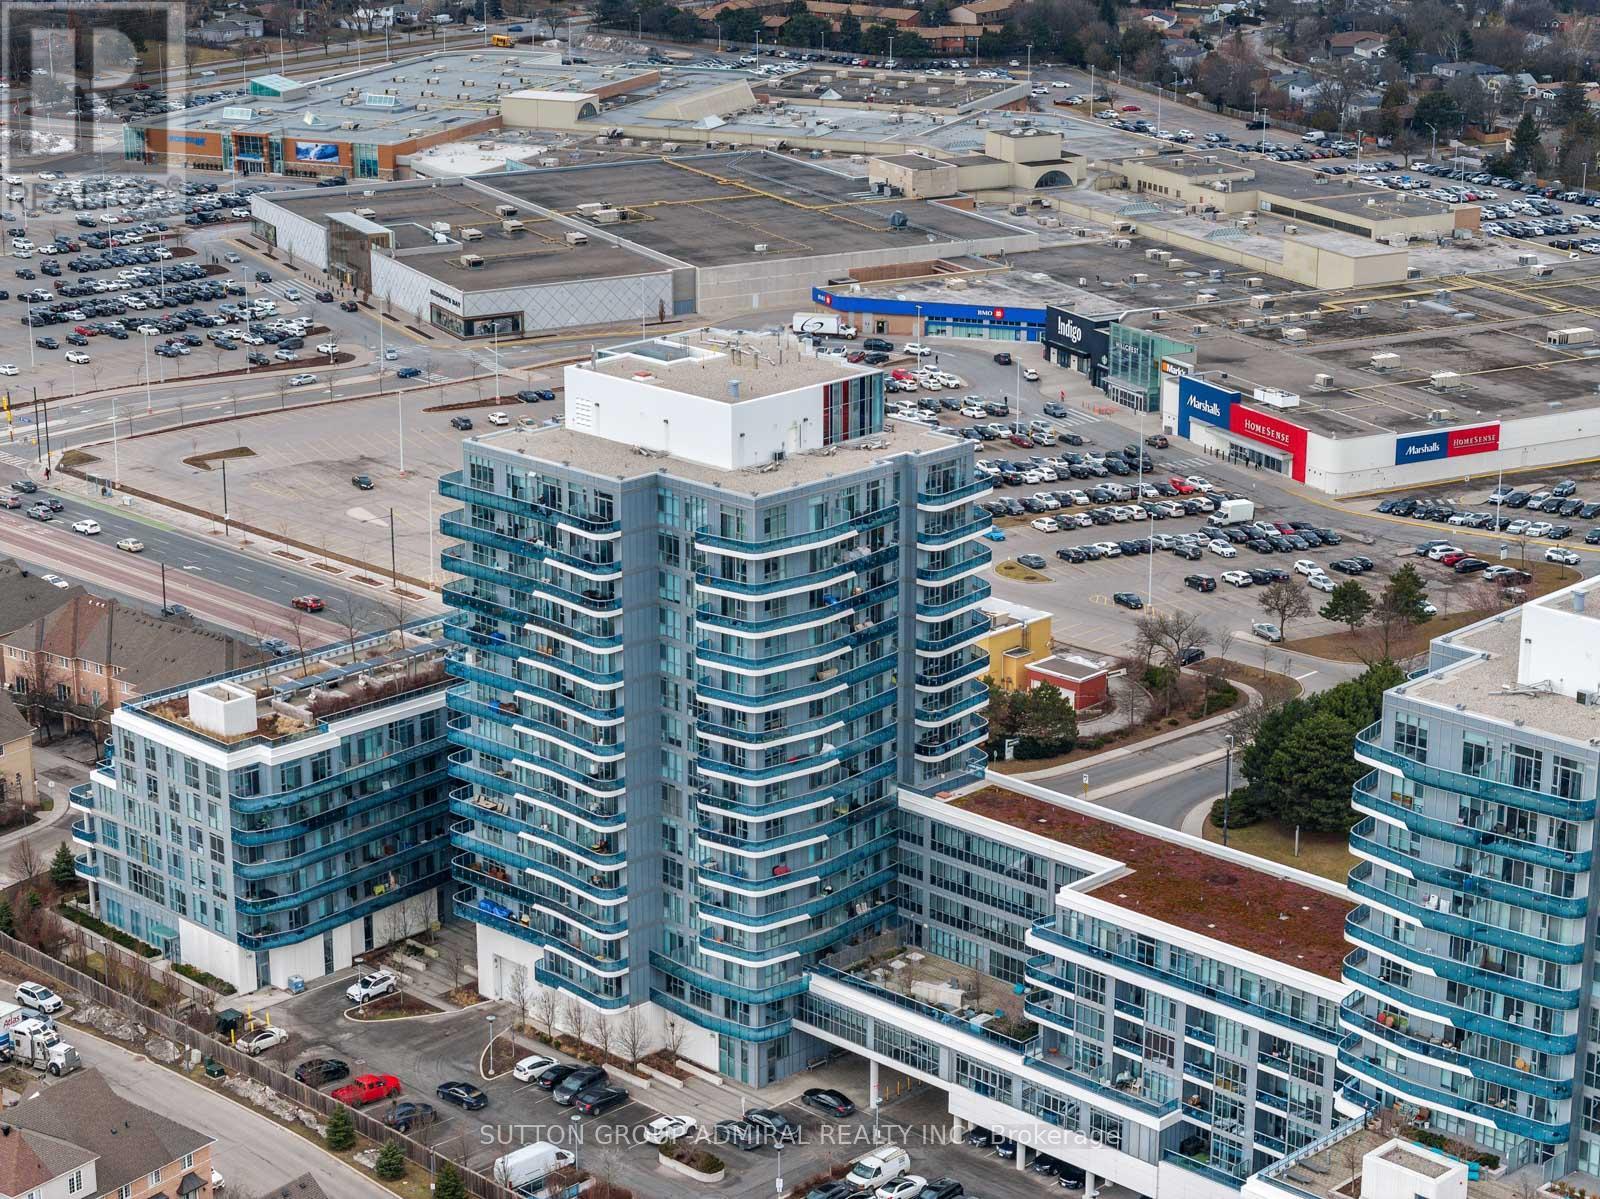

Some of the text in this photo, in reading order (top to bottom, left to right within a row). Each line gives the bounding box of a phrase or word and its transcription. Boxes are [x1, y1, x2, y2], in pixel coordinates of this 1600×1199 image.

[1057, 315, 1082, 343] Indigo
[1187, 394, 1221, 417] Marshalls
[1405, 442, 1440, 455] Marshalls
